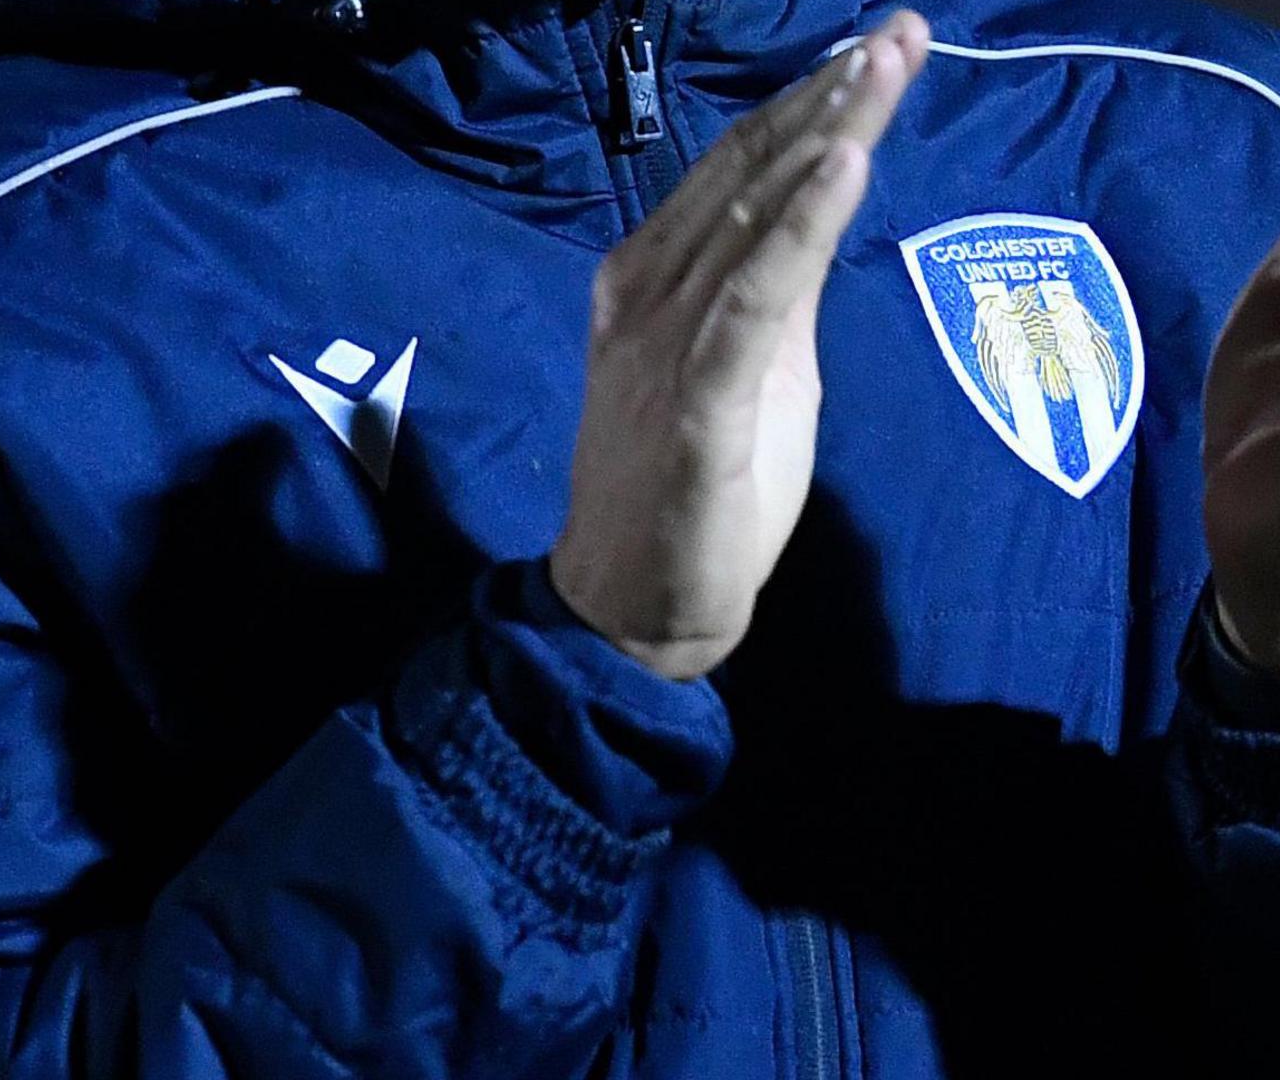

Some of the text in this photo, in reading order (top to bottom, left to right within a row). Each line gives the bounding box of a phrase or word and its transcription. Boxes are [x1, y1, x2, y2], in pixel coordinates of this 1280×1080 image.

[929, 236, 1077, 263] COLCHESTER
[958, 260, 1070, 284] UNITED FC
